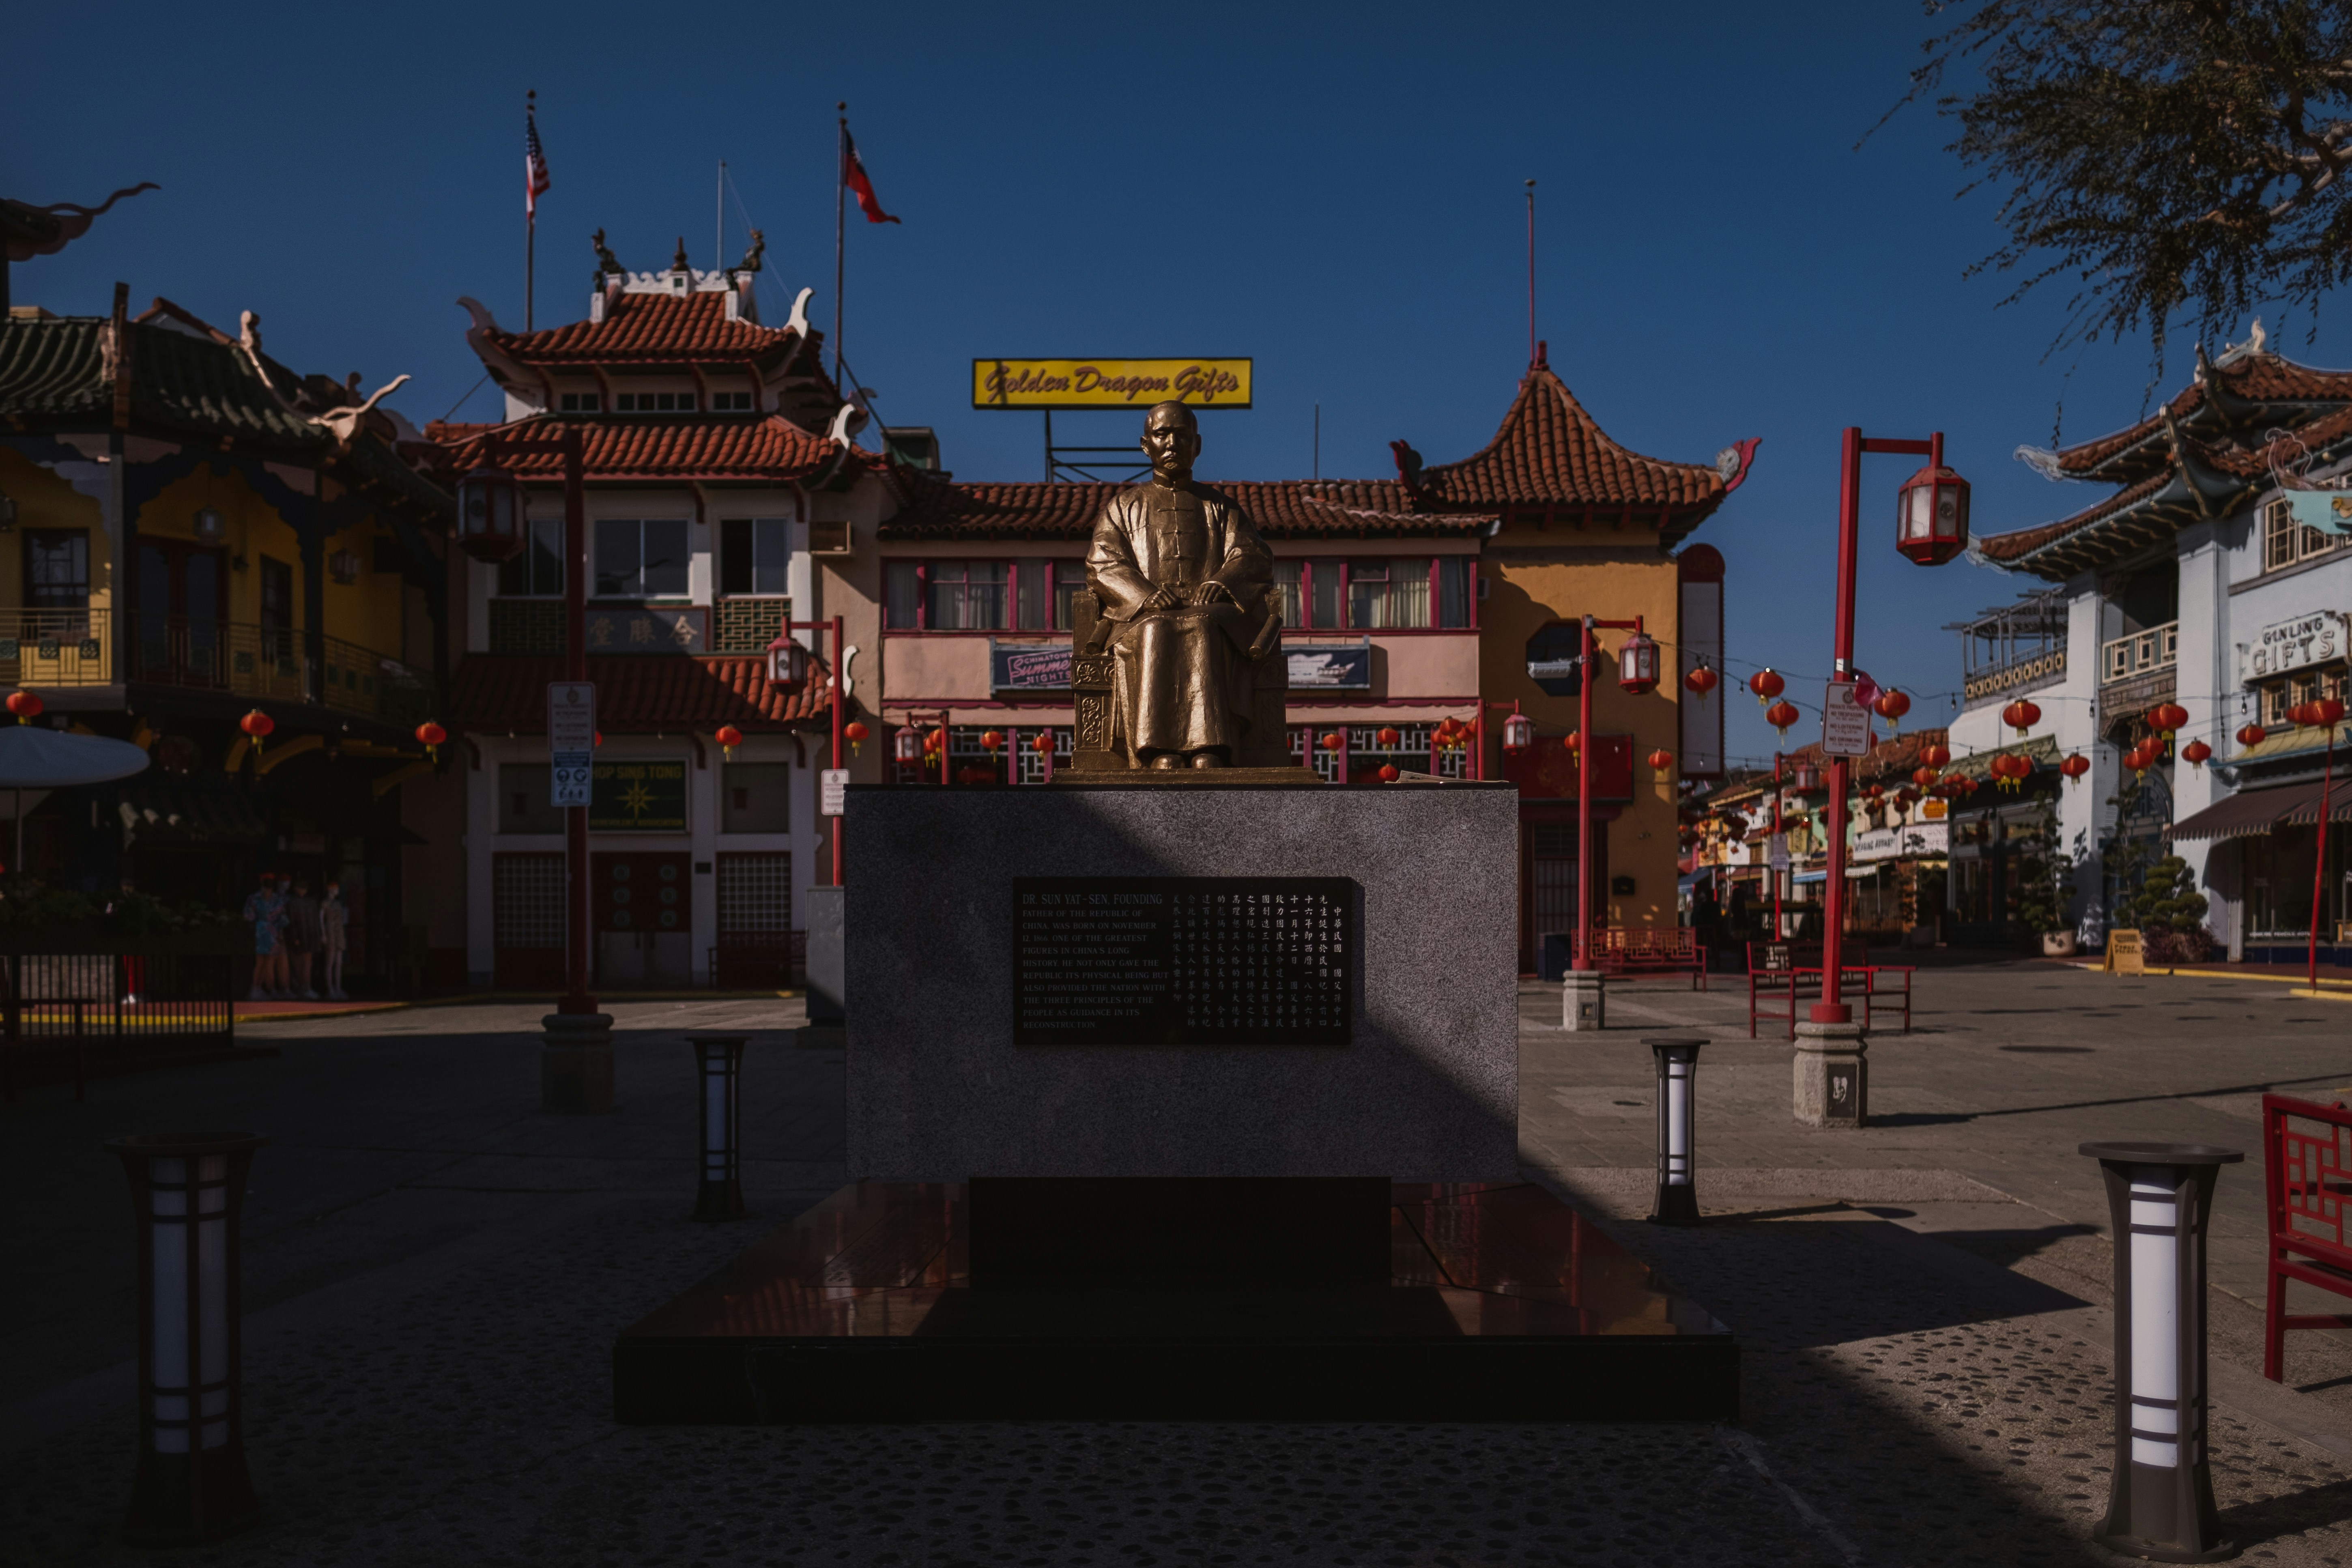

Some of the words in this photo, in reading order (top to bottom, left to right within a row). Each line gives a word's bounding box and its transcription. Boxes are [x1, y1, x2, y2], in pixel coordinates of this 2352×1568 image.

[984, 365, 1070, 402] Golden
[1073, 365, 1169, 401] Dragon
[1173, 365, 1239, 402] Gifts
[2252, 630, 2335, 675] GIFTS
[1012, 658, 1071, 678] Summe
[1026, 671, 1071, 684] NIGHTS
[616, 765, 645, 779] SING
[648, 765, 682, 779] TONG
[1023, 894, 1038, 904] DR.
[1041, 894, 1061, 905] SUN
[1114, 894, 1163, 904] FOUNDING
